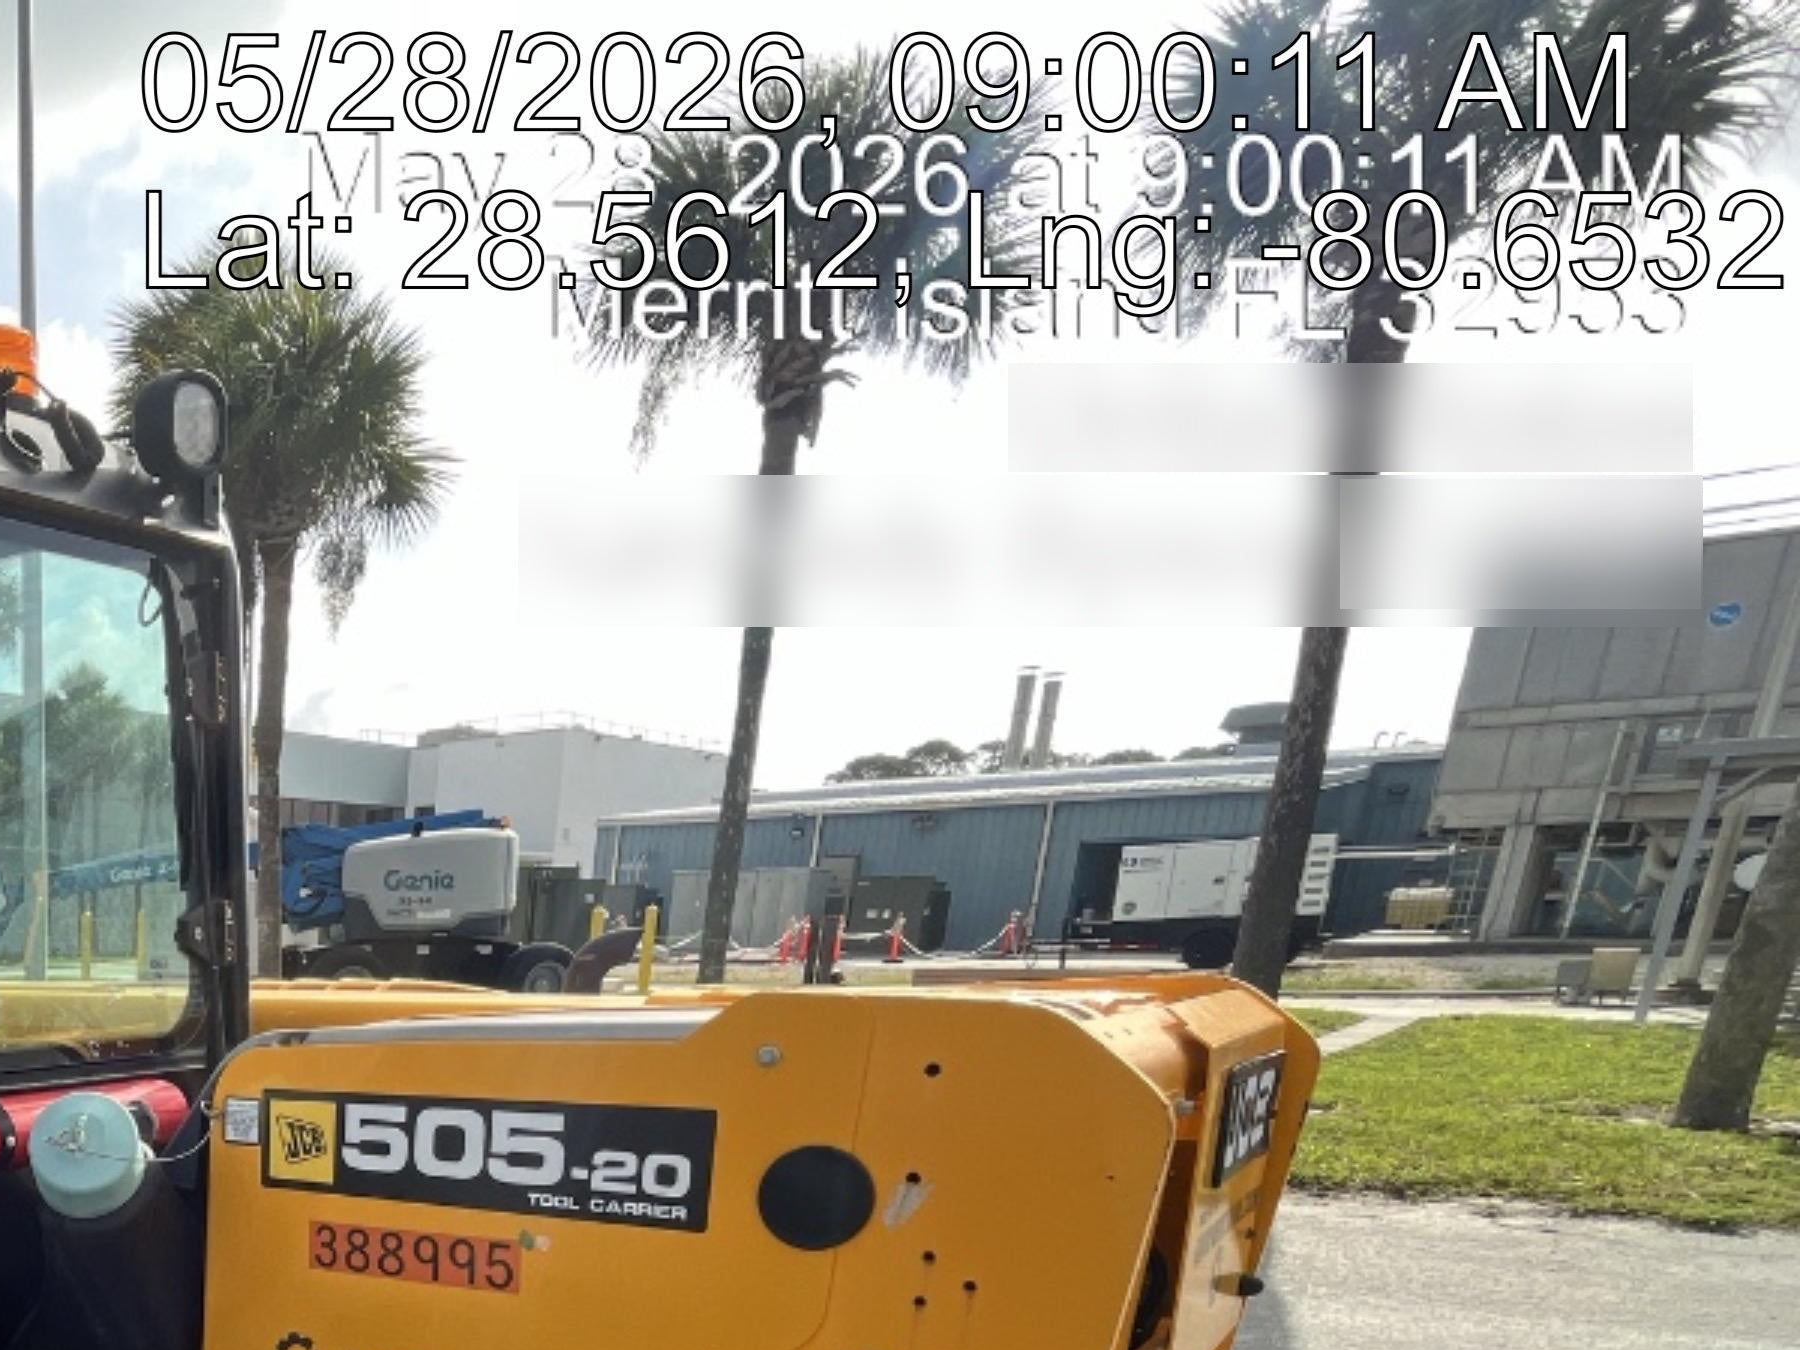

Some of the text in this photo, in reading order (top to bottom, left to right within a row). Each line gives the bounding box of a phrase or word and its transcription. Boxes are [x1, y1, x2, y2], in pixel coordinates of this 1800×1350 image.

[383, 869, 456, 892] Genie
[274, 1113, 327, 1165] JCB
[340, 1102, 692, 1199] 505-20
[528, 1192, 687, 1221] TOOL CARRIER
[313, 1223, 514, 1291] 388995
